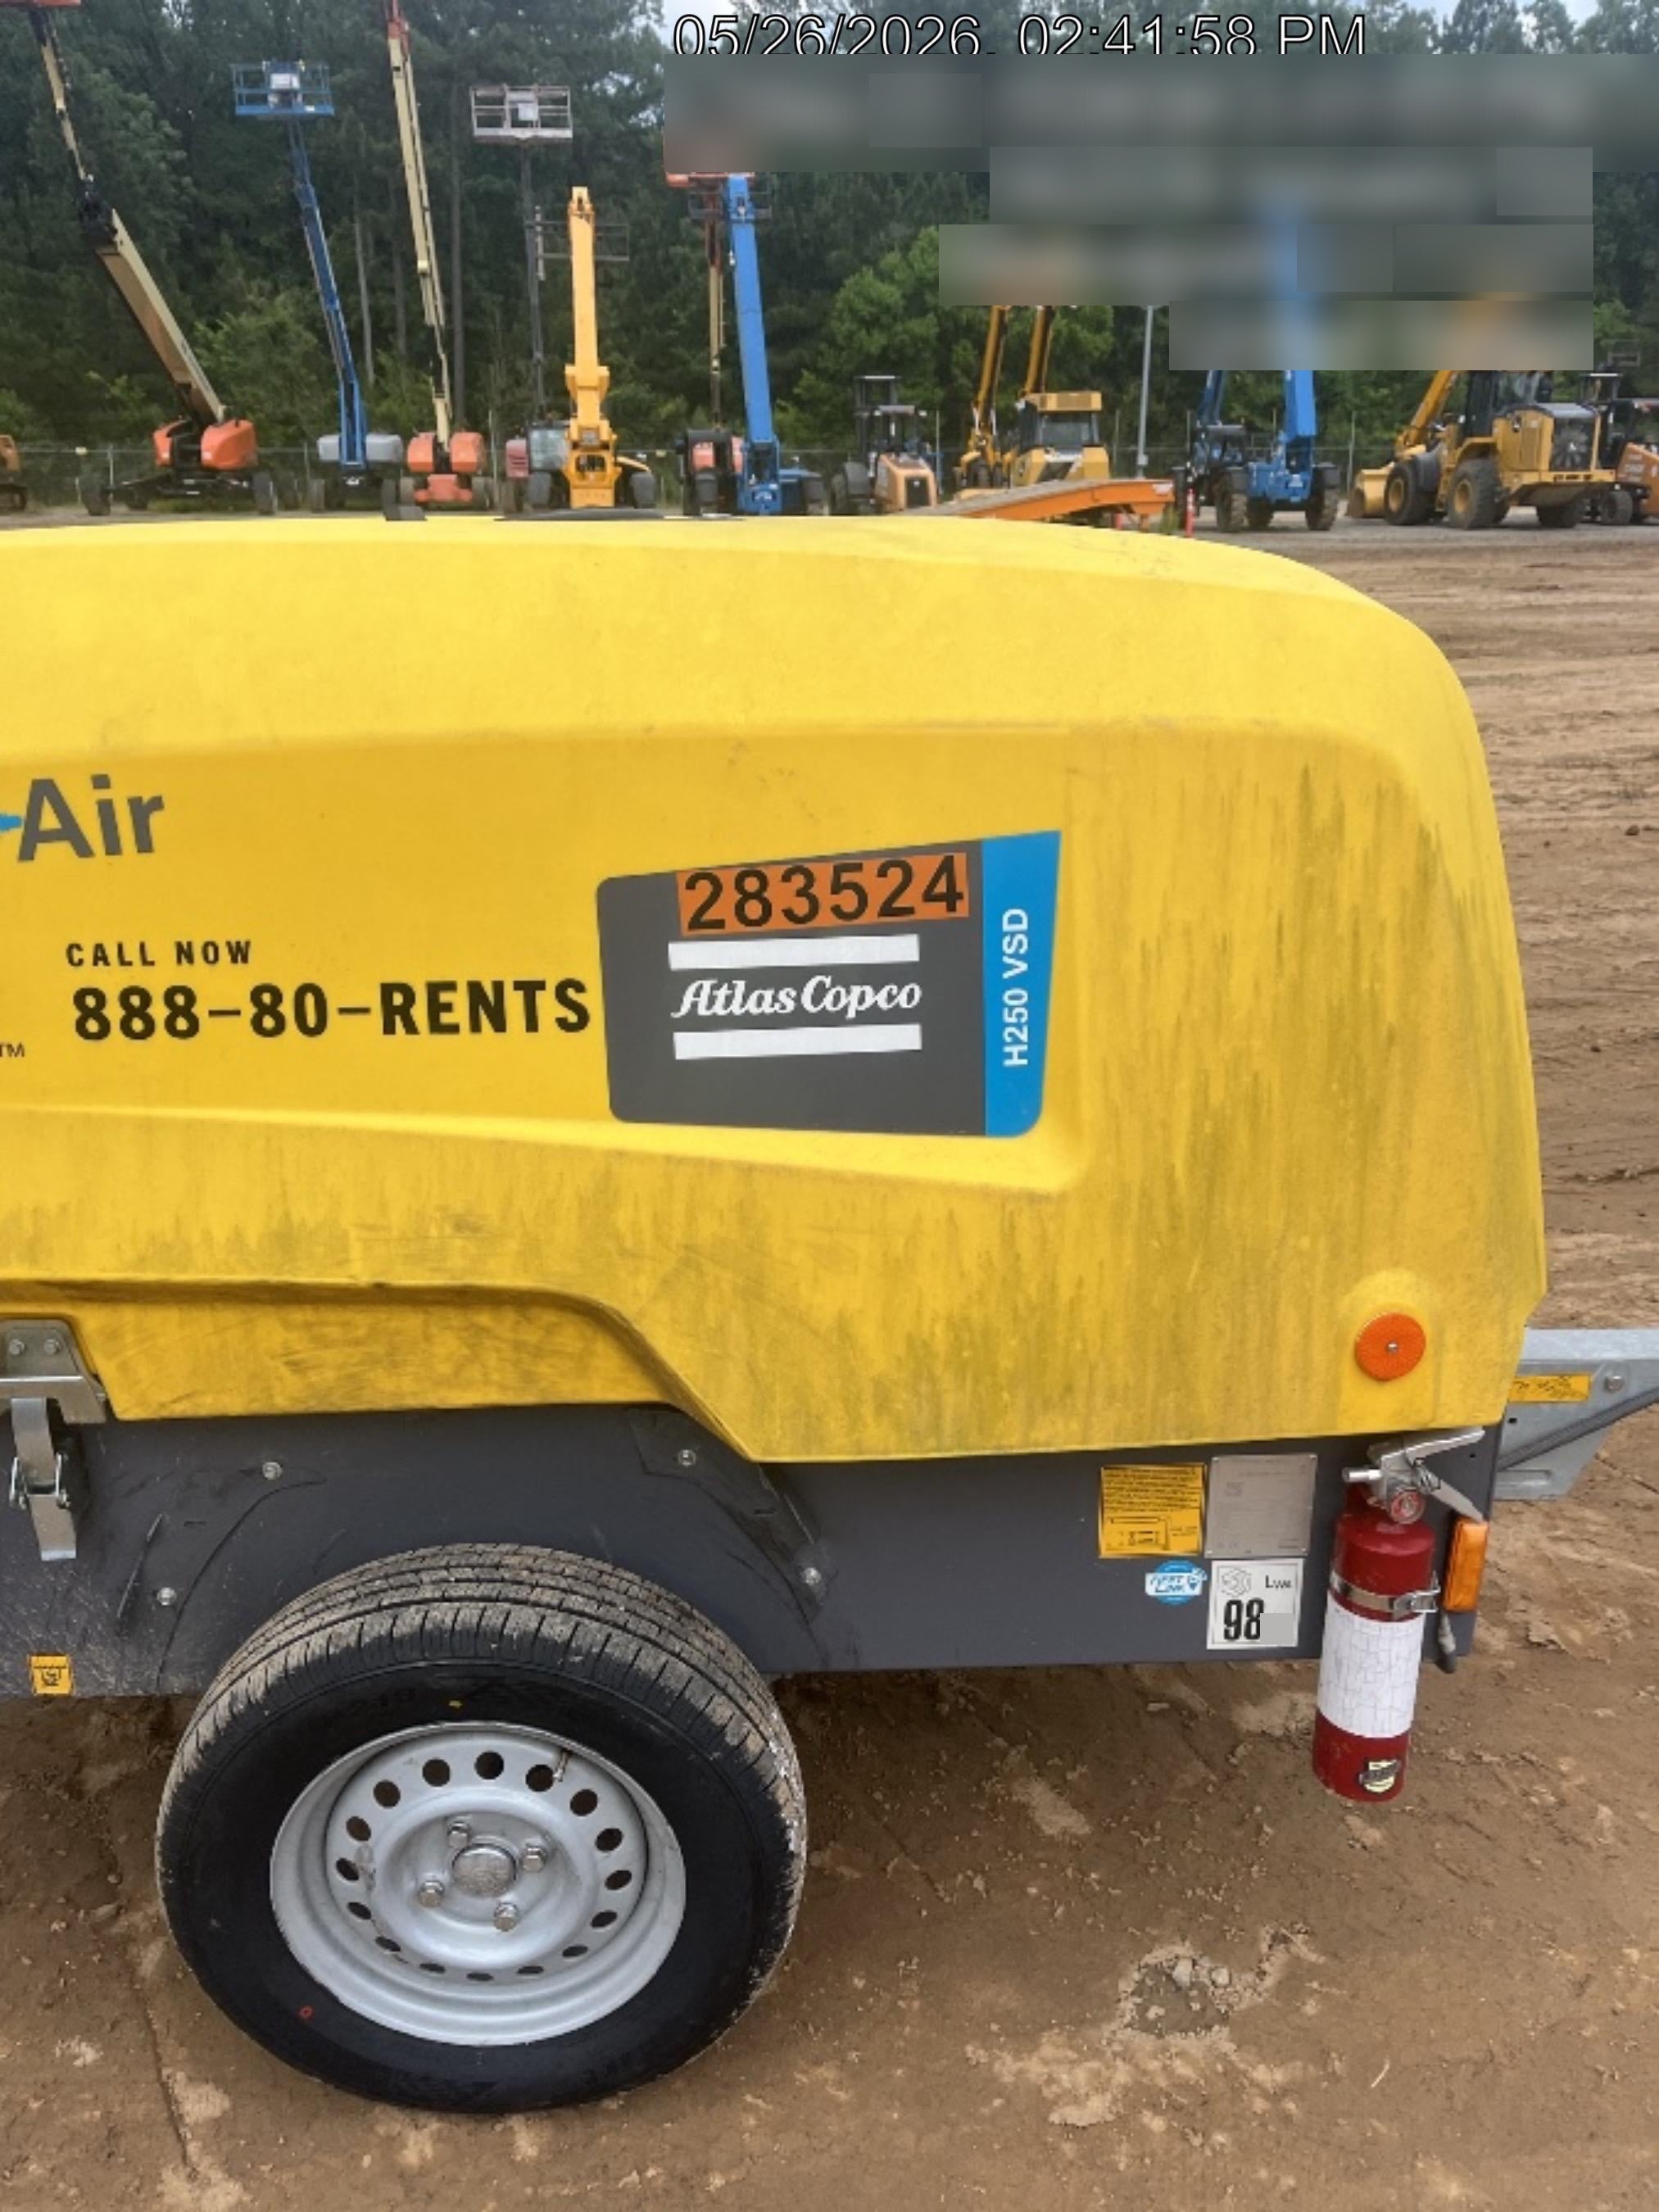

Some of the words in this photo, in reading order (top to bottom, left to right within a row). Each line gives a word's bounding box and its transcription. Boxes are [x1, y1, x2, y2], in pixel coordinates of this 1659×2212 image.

[19, 774, 165, 862] Air
[685, 854, 964, 931] 283524
[66, 941, 156, 968] CALL
[175, 941, 252, 966] NOW
[1002, 908, 1028, 980] VSD
[73, 977, 591, 1041] 888-80-RENTS
[670, 979, 796, 1018] Atlas
[801, 975, 922, 1019] Copco
[1003, 988, 1028, 1067] H250
[1223, 1598, 1264, 1641] 98
